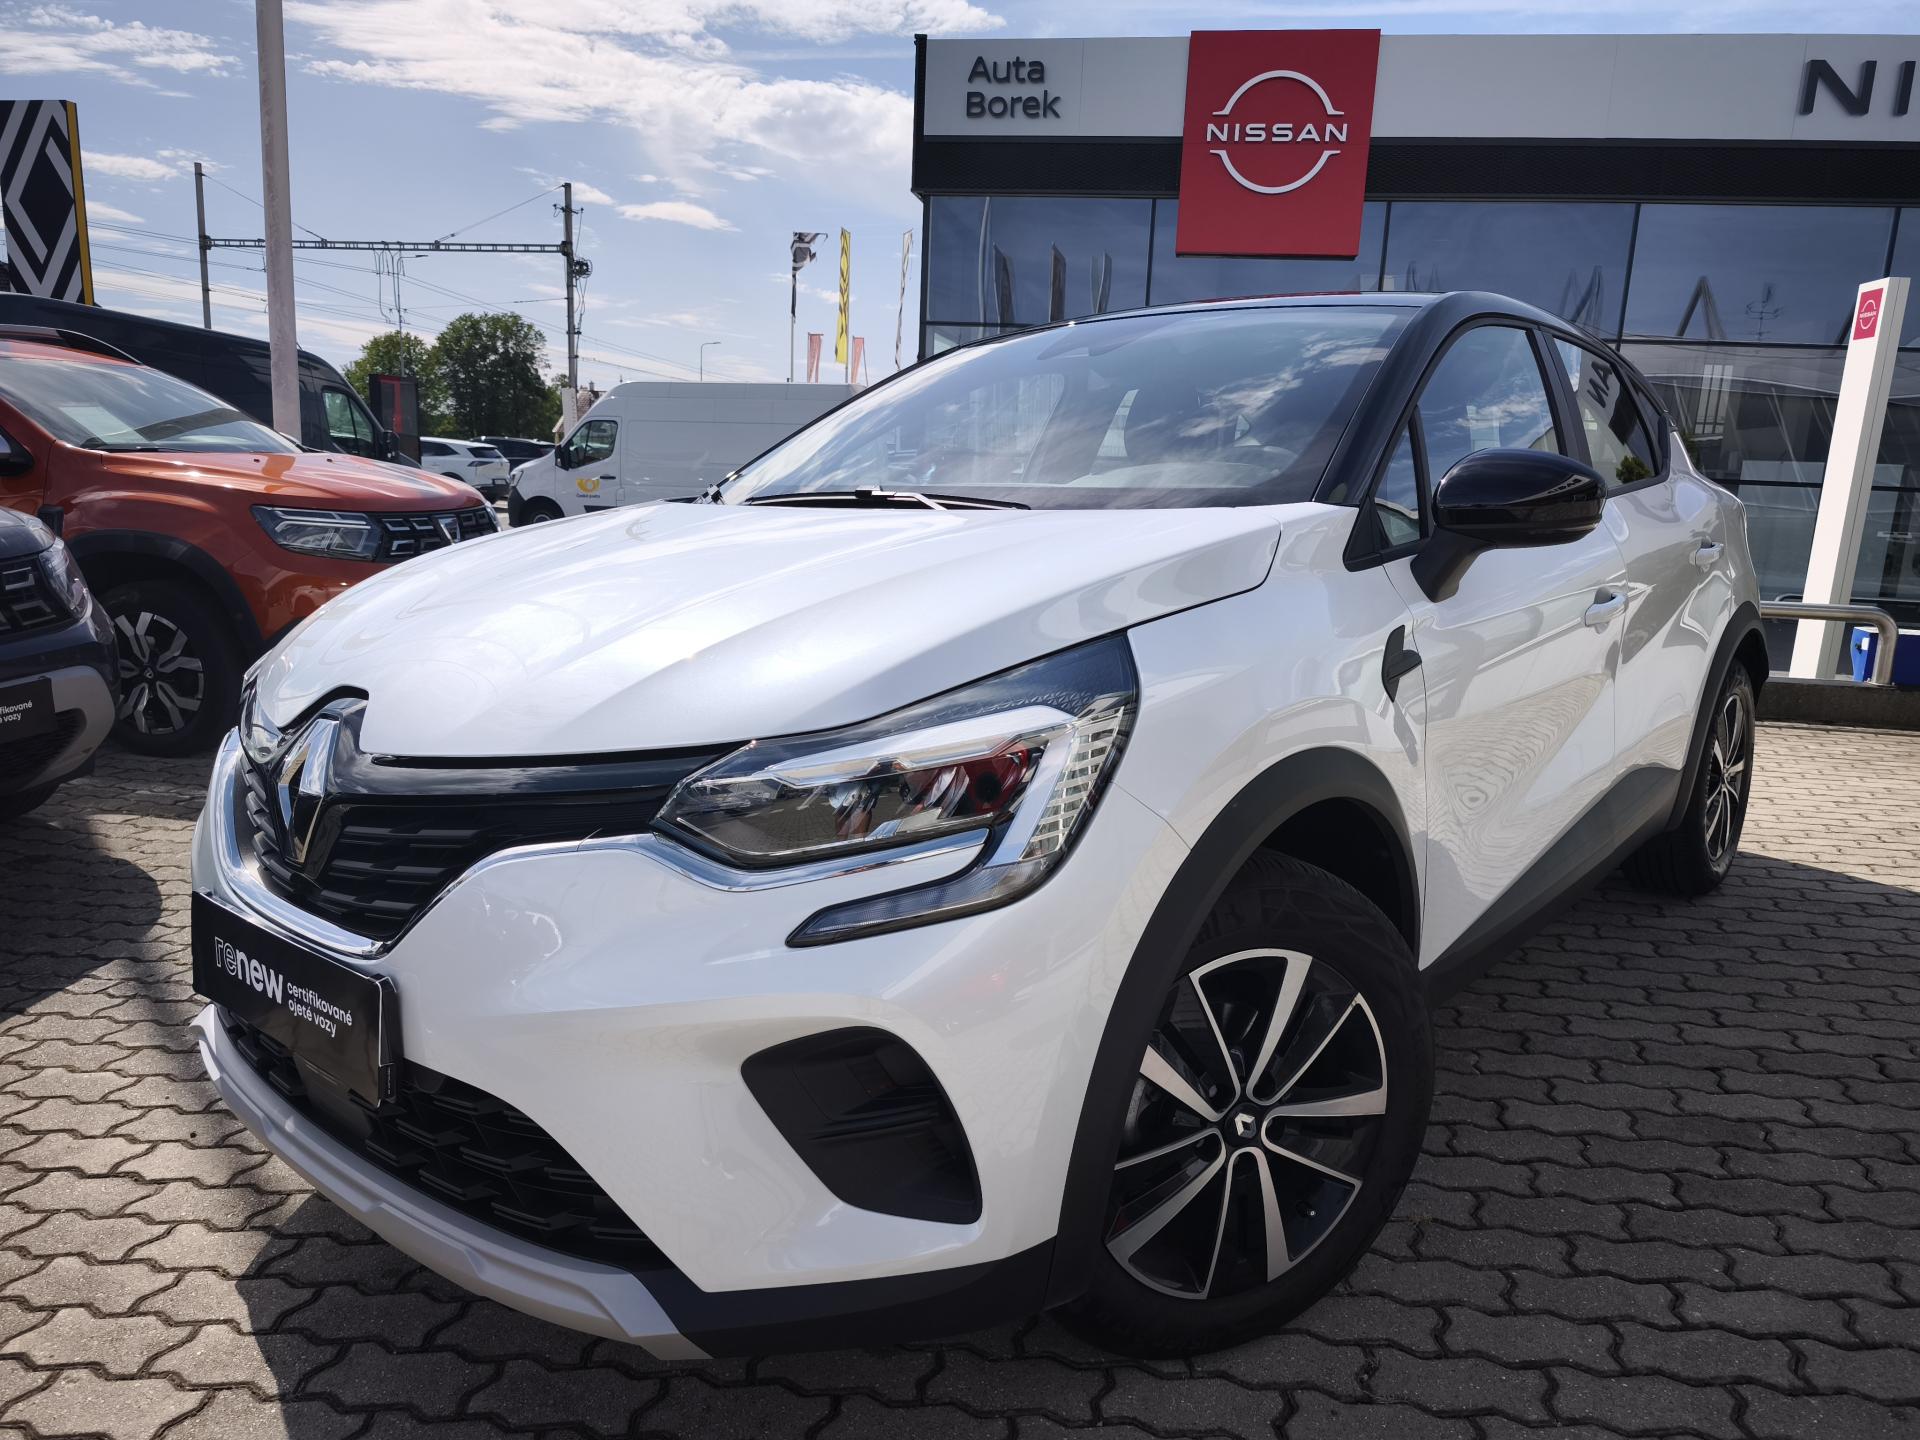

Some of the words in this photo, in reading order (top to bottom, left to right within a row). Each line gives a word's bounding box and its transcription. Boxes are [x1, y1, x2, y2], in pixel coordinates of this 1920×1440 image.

[967, 55, 1045, 83] Auta
[966, 90, 1061, 118] Borek
[1206, 123, 1348, 142] NISSAN
[3, 712, 22, 723] vozy
[214, 936, 284, 1004] renew
[287, 982, 352, 1026] certifikované
[288, 999, 313, 1021] ojeté
[314, 1013, 337, 1038] vozy
